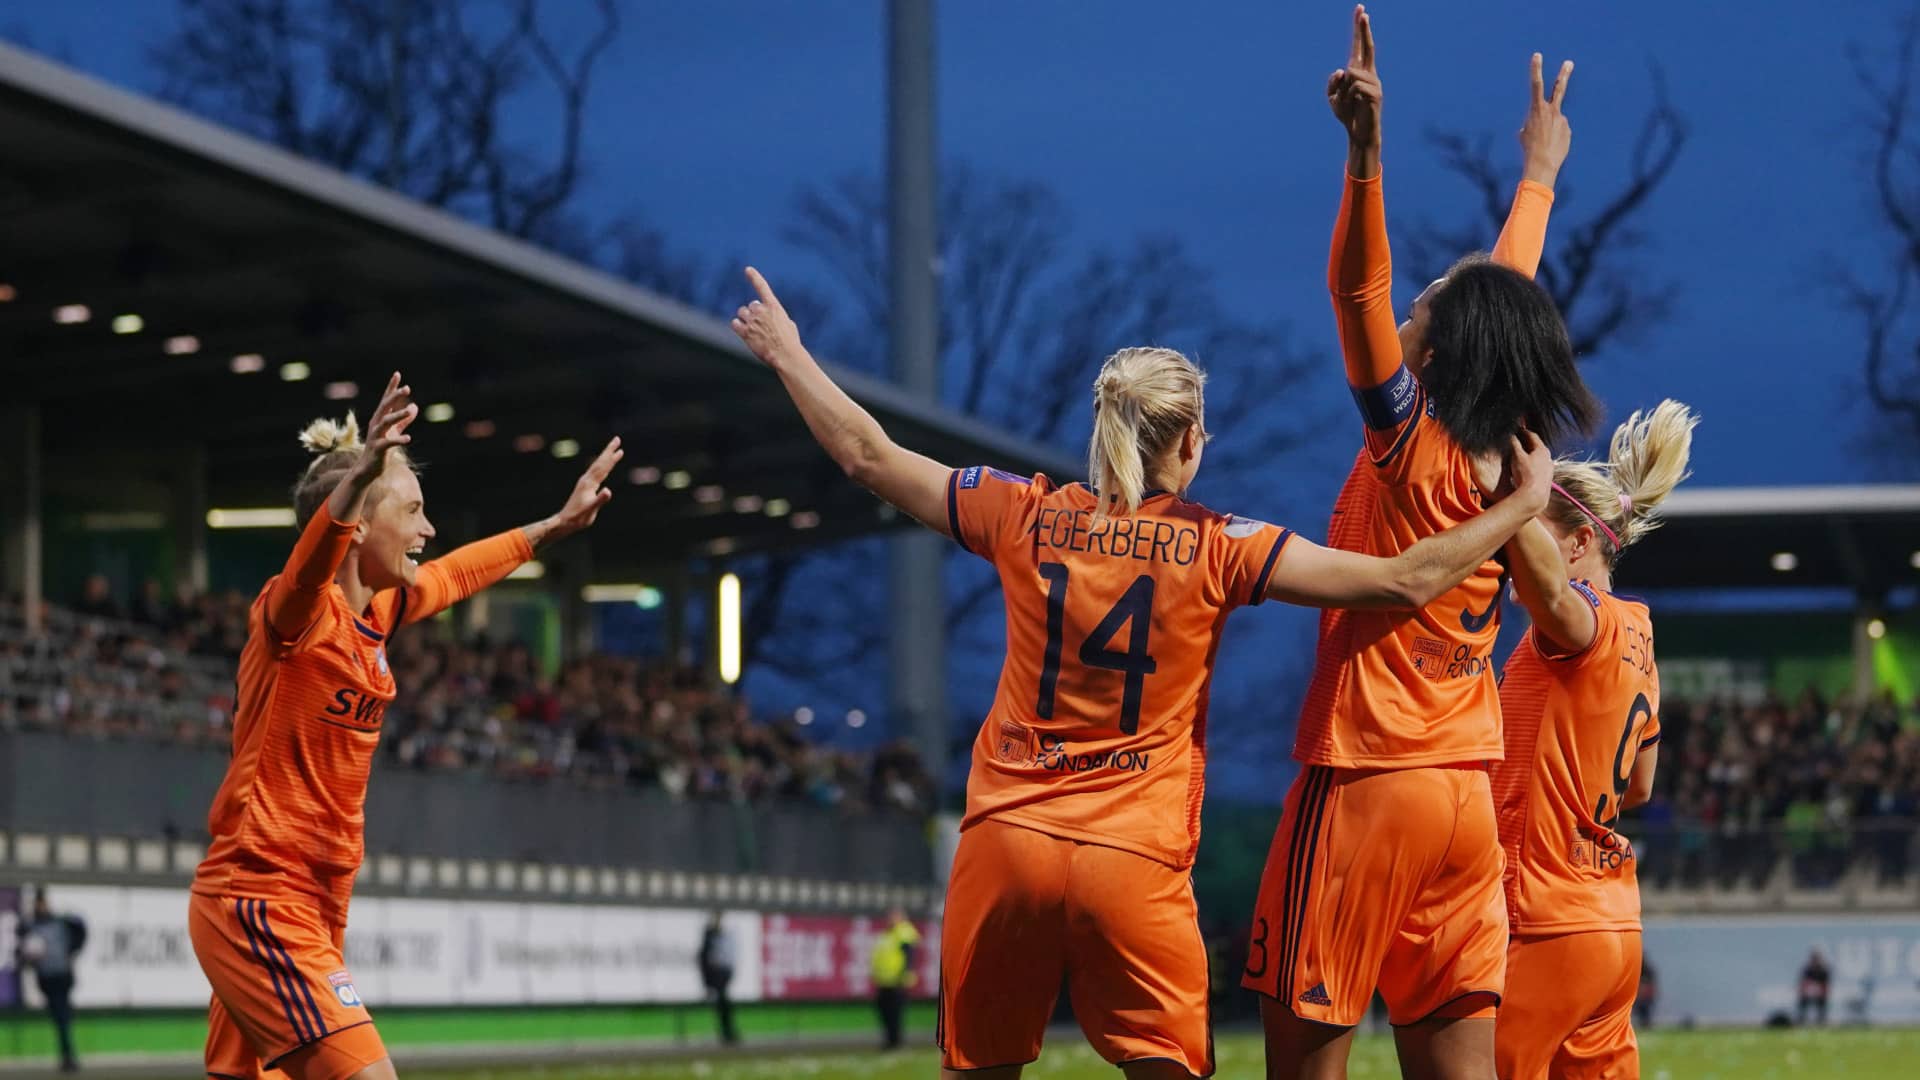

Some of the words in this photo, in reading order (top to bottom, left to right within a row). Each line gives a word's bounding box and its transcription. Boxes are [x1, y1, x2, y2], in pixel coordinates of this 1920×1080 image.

[1028, 508, 1198, 566] EGERBERG
[1036, 562, 1157, 736] 14
[325, 687, 384, 724] SW
[1035, 751, 1149, 771] FONDATION
[1594, 692, 1651, 829] 9
[1246, 917, 1268, 978] 3
